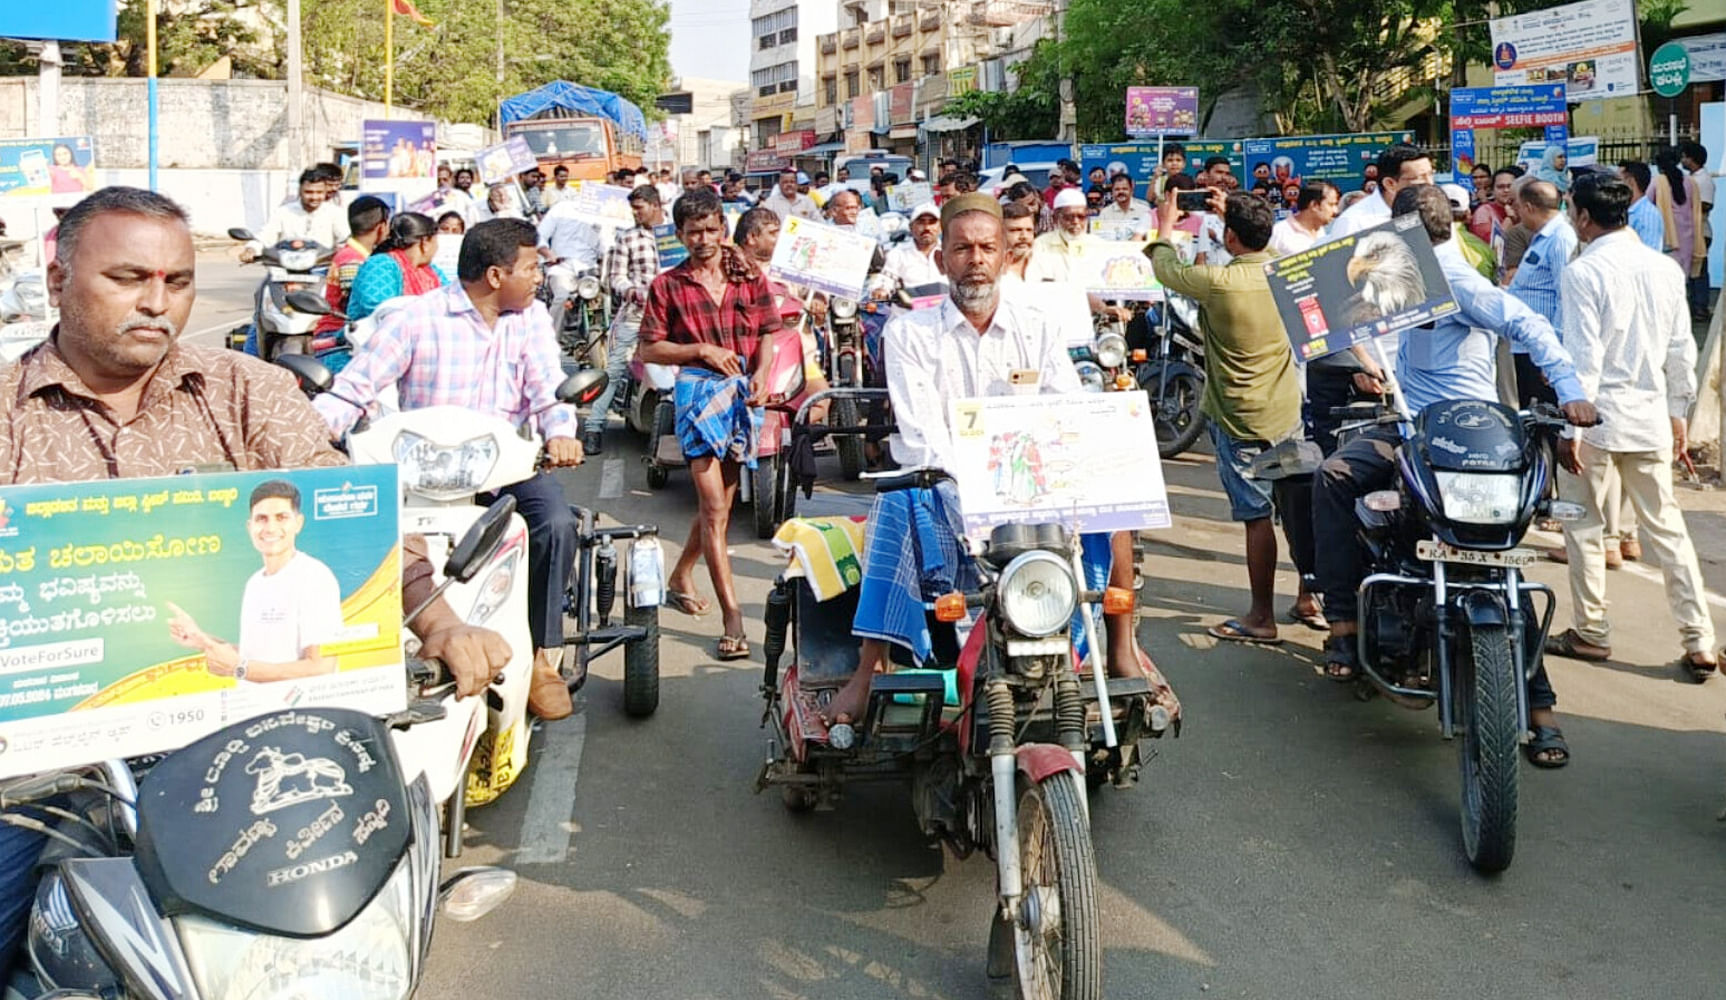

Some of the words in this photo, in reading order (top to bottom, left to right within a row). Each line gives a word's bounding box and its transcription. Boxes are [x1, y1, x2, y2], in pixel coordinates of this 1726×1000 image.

[1504, 113, 1533, 125] SELFIE
[1535, 112, 1565, 124] BOOTH
[963, 411, 977, 429] 7
[50, 533, 222, 568] ಚಲಾಯಿಸೋಣ
[1429, 548, 1448, 560] KA
[0, 646, 99, 669] VoteForSure
[168, 709, 205, 726] 1950
[194, 787, 219, 813] ಶ್ರೀ
[267, 850, 359, 887] HONDA
